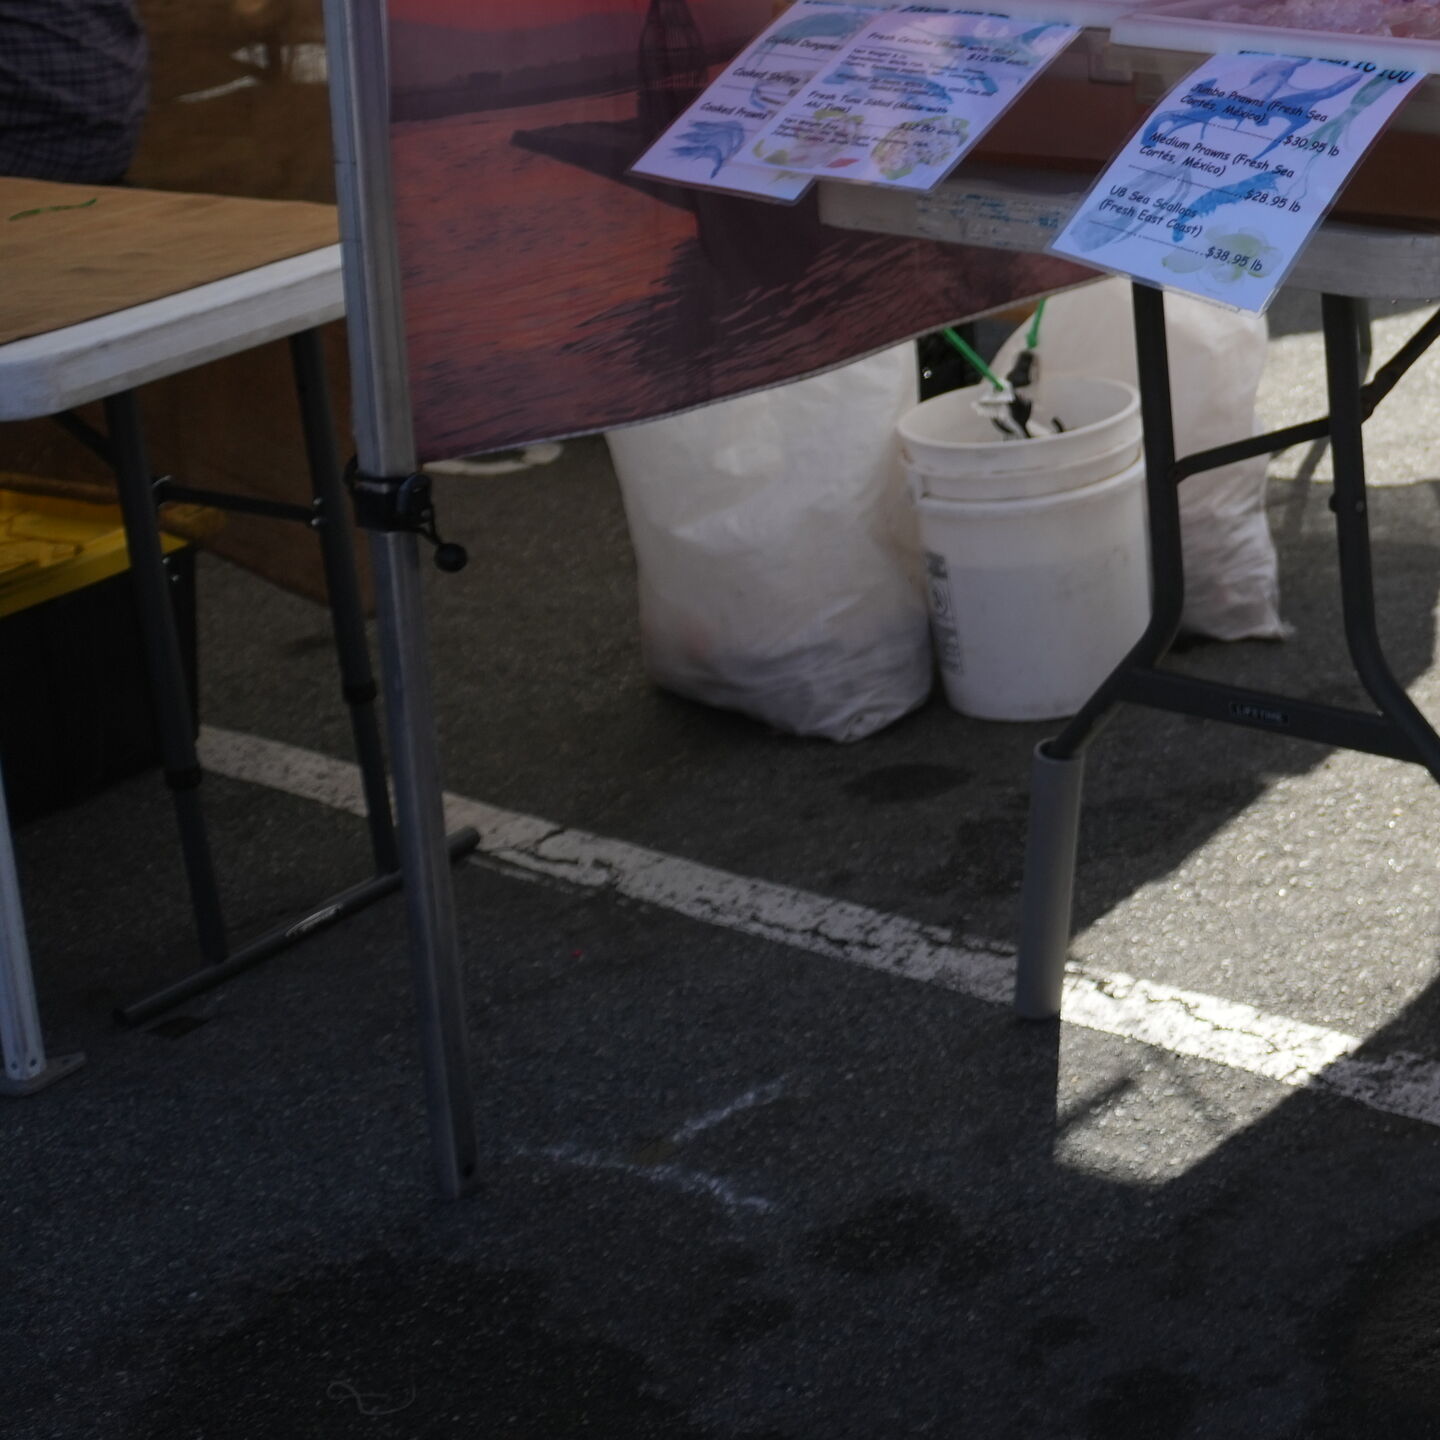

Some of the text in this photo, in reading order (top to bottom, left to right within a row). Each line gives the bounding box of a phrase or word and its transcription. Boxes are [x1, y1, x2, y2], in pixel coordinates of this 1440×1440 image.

[868, 32, 933, 47] Fresh Ceviche
[733, 68, 766, 78] Cooked
[700, 102, 734, 114] Cooked
[807, 91, 894, 108] Fresh Salad
[1190, 82, 1328, 123] Jumbo Prawns (Fresh Sea
[1285, 133, 1325, 155] $30.95
[1149, 132, 1295, 179] Medium Prawns (Fresh Sea
[1183, 154, 1227, 177] México)
[1128, 189, 1199, 220] Sea Scallops
[1243, 187, 1285, 210] $28.95
[1098, 197, 1134, 219] (Fresh
[1137, 209, 1164, 227] East
[1166, 216, 1203, 238] Coast)
[1205, 246, 1247, 268] $38.95
